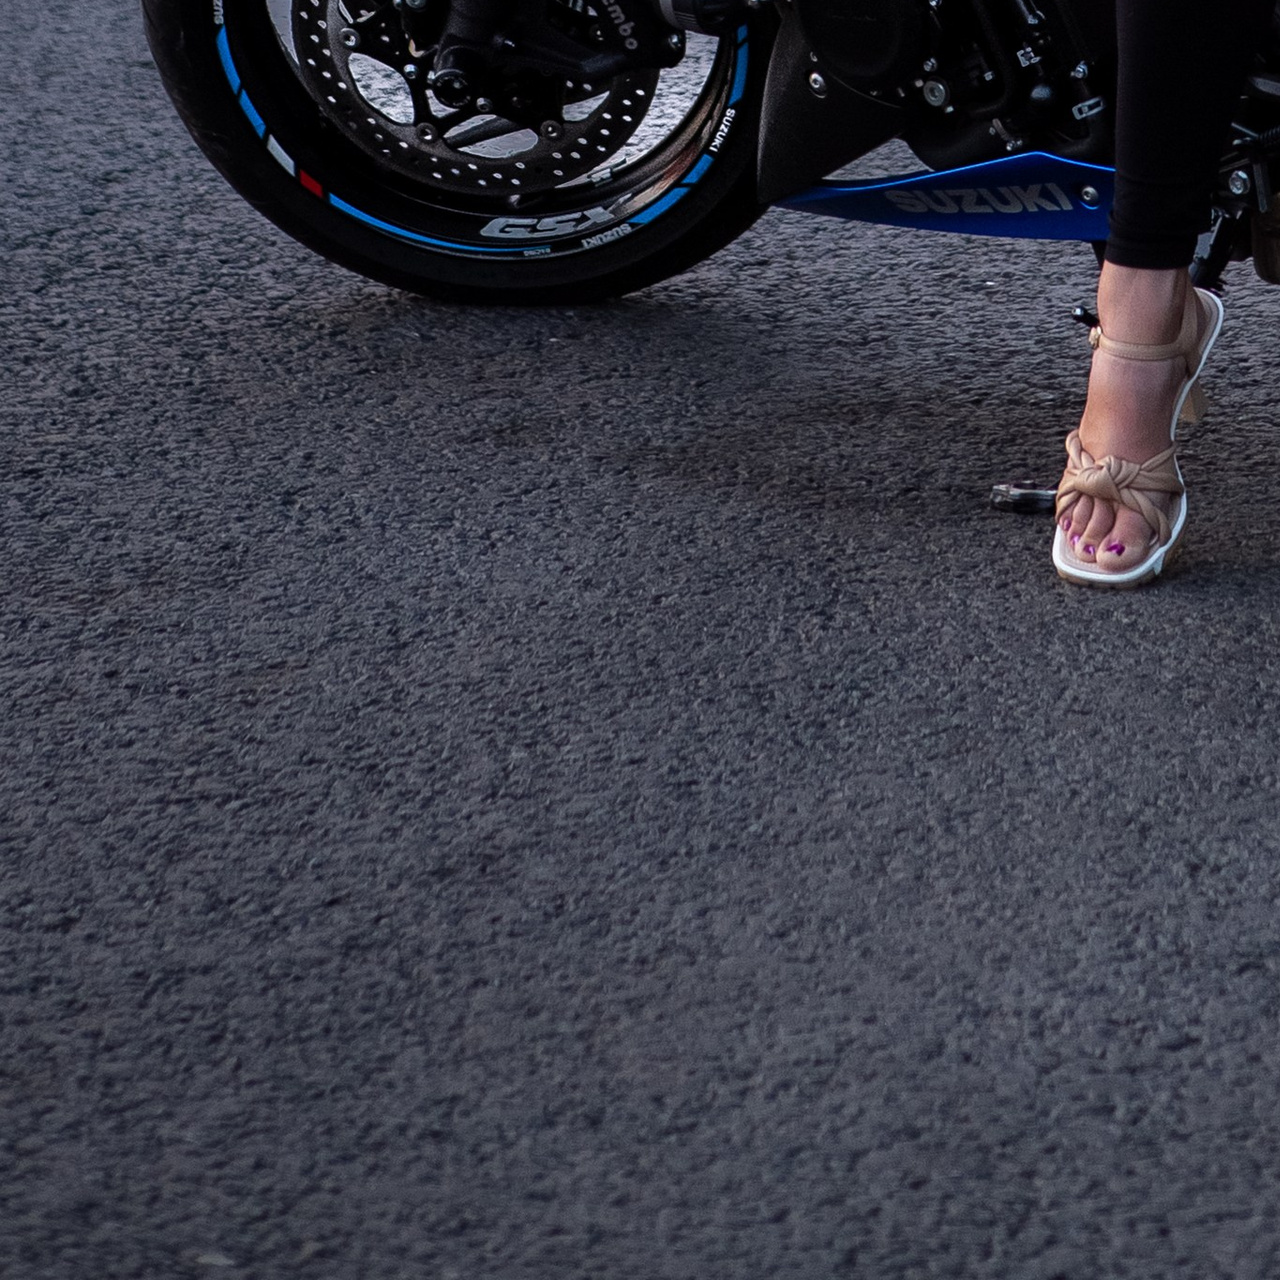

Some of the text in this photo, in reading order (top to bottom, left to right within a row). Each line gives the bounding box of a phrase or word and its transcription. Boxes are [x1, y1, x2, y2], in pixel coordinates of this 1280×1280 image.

[709, 106, 737, 153] SUZUKI
[479, 192, 633, 240] GSX
[885, 182, 1075, 214] SUZUKI
[580, 222, 633, 249] SUZUKI
